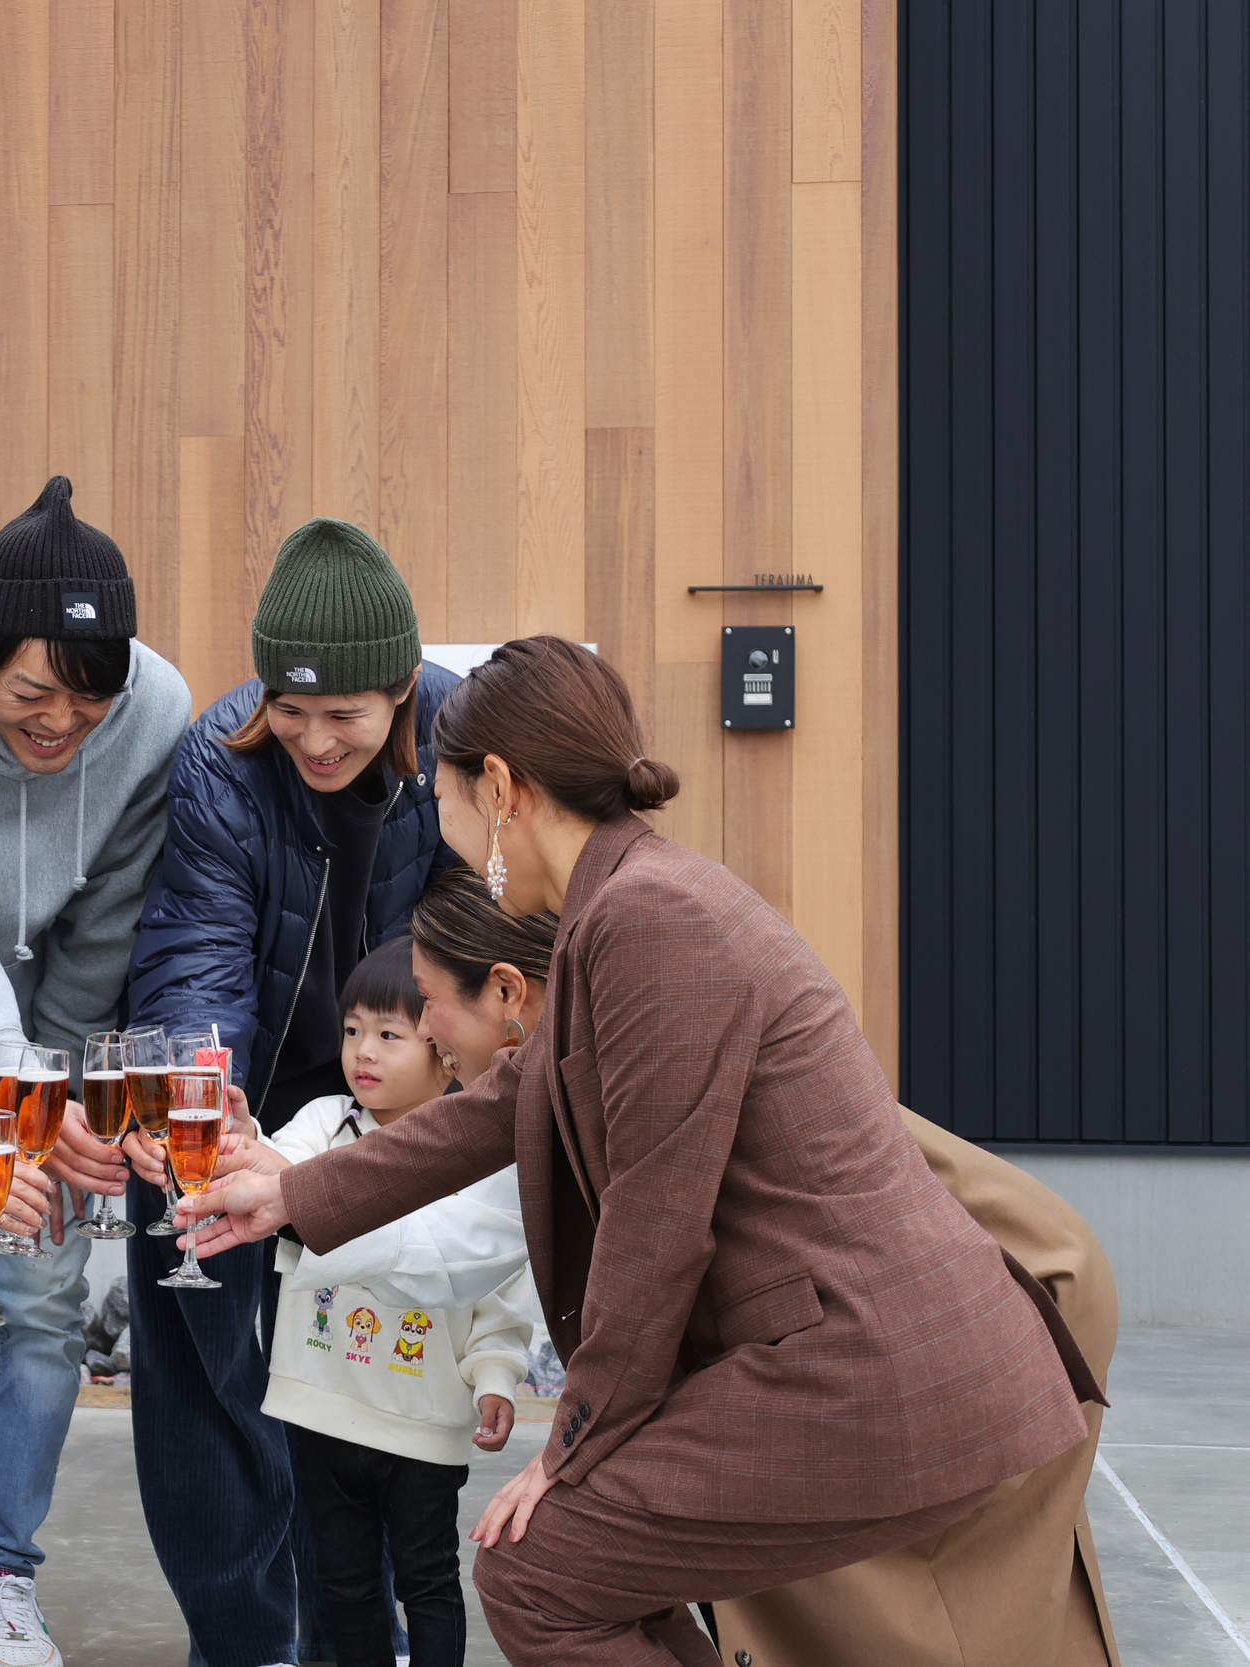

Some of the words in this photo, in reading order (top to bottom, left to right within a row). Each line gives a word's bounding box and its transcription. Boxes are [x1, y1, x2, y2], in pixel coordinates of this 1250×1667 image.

[306, 1337, 332, 1352] ROCKY
[346, 1352, 371, 1364] SKYE
[388, 1362, 423, 1377] RUBBLE
